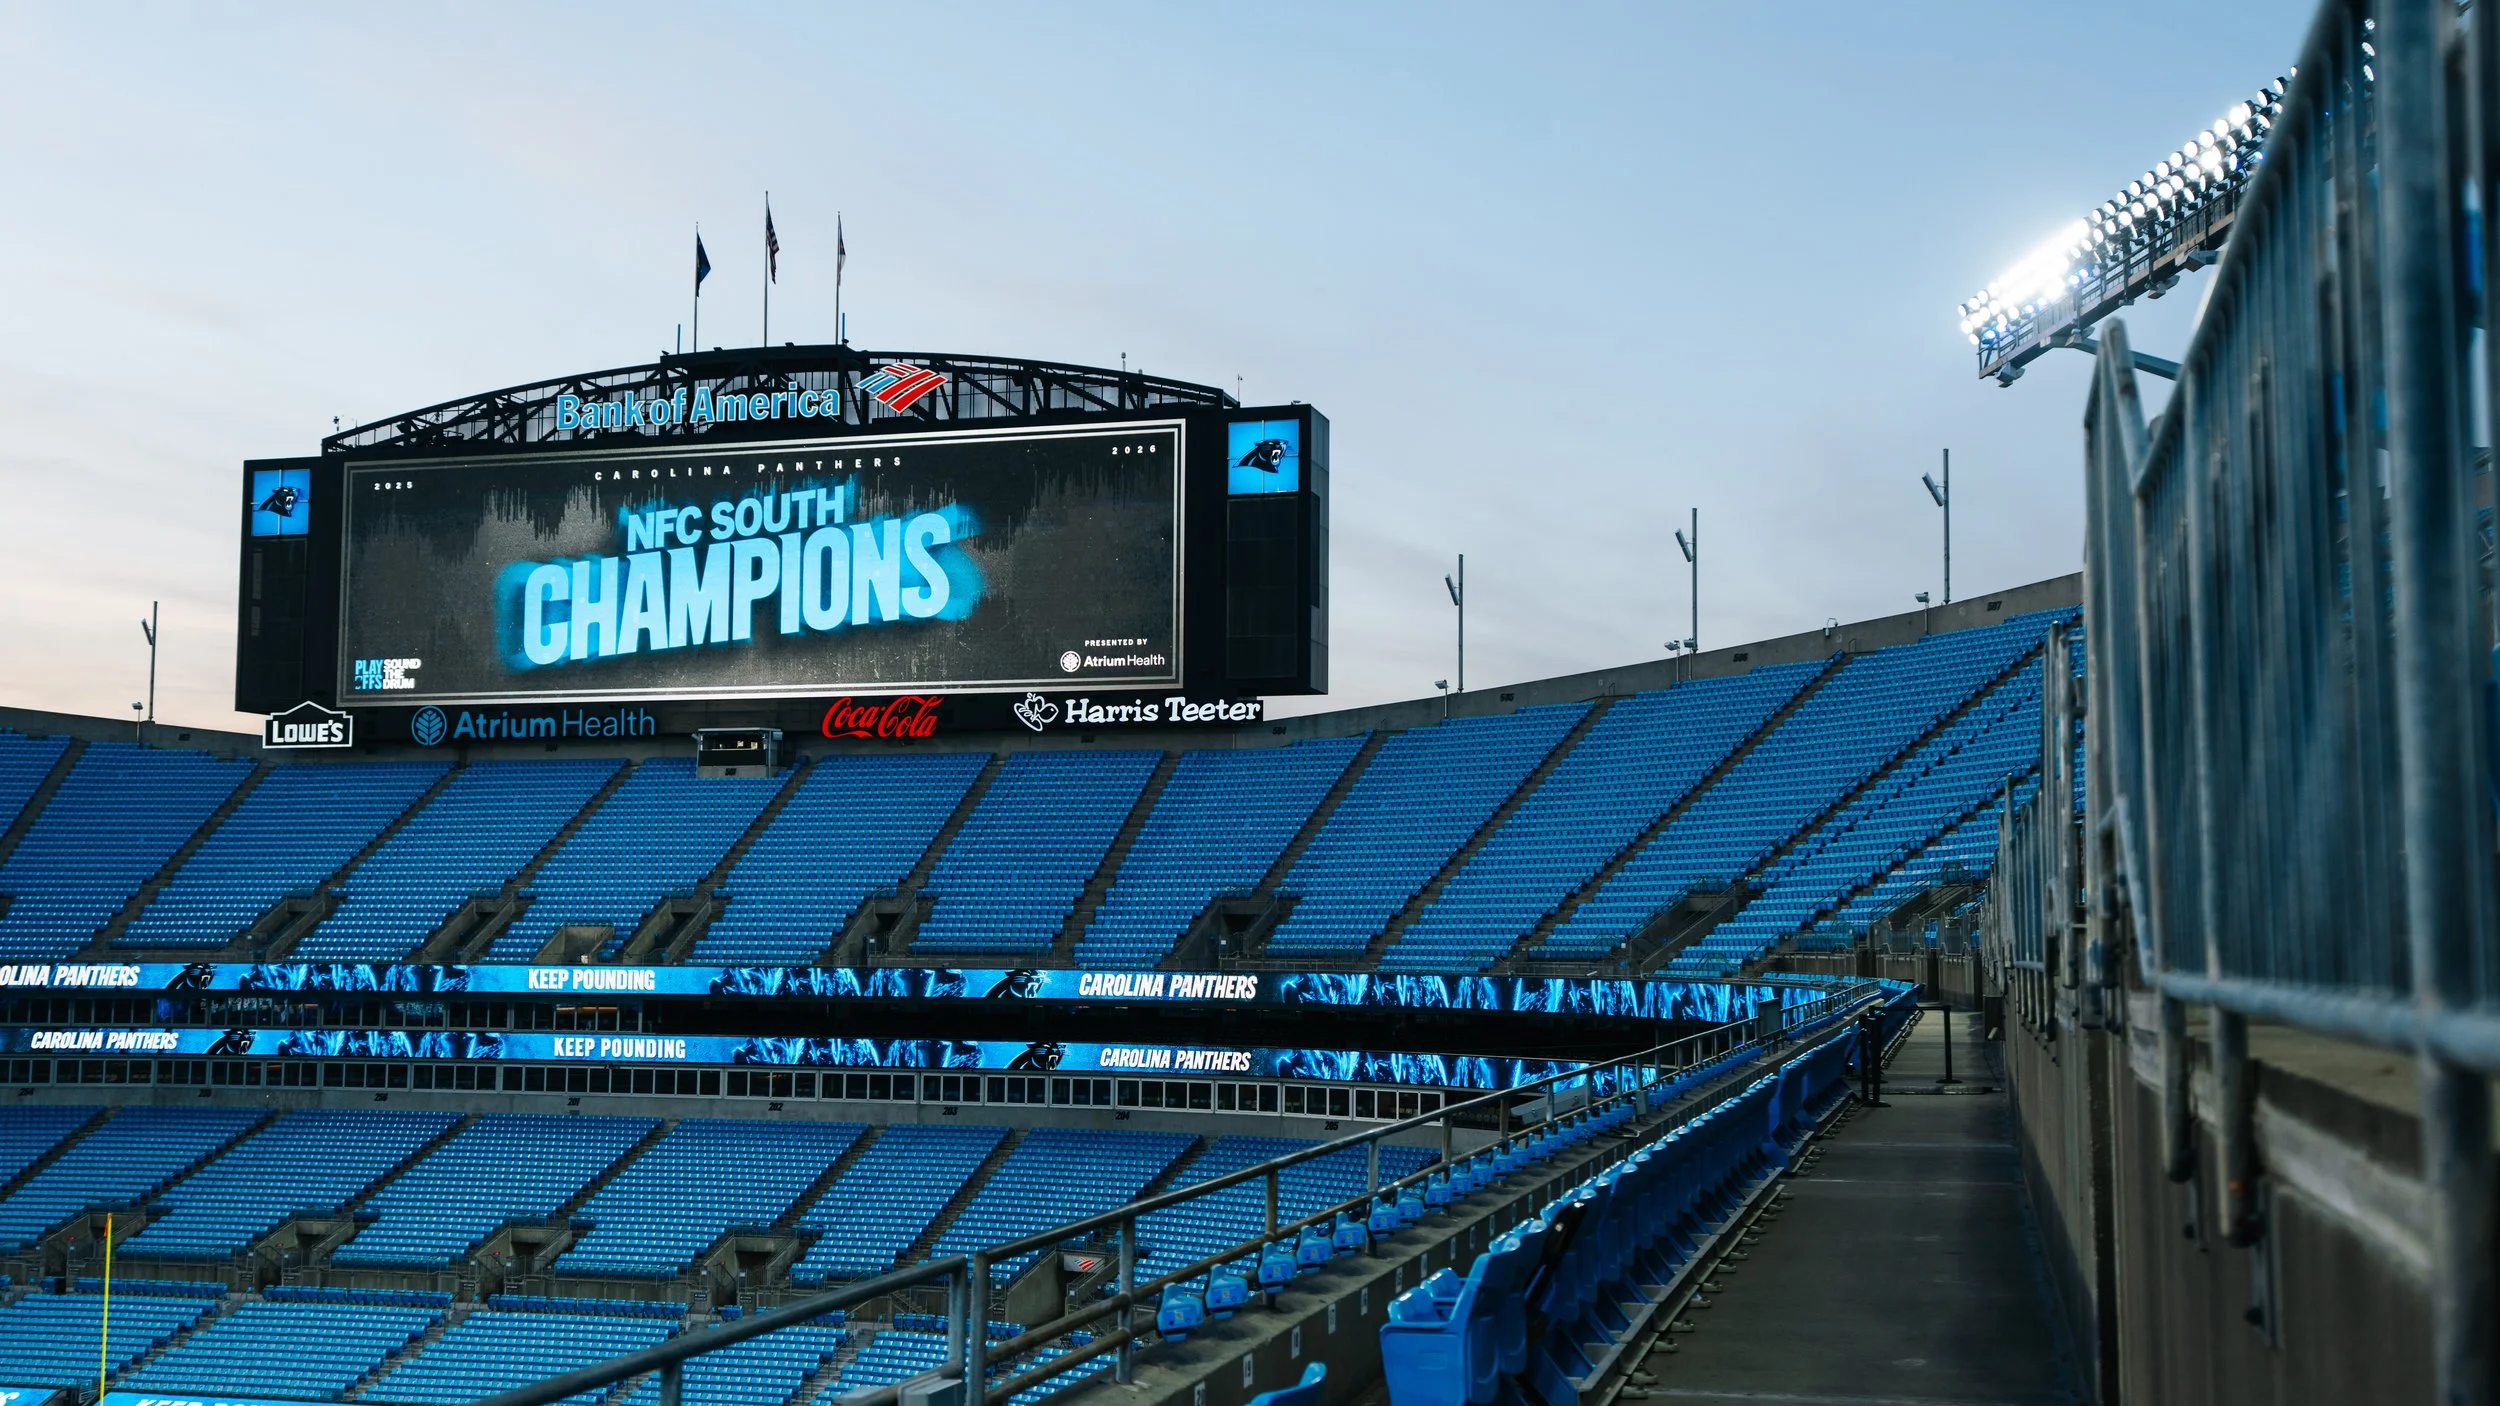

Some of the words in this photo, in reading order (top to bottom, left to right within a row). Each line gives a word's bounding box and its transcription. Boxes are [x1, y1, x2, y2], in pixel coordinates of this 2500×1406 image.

[556, 390, 645, 431] Bank
[650, 387, 688, 426] of
[690, 381, 841, 423] America
[1112, 444, 1156, 455] 2026
[594, 465, 731, 481] CAROLINA
[757, 457, 901, 474] PANTHERS
[374, 481, 412, 490] 2025
[627, 505, 701, 552] NFC
[710, 485, 845, 540] SOUTH
[523, 513, 951, 666] CHAMPIONS
[1085, 638, 1134, 646] PRESENTED
[355, 660, 383, 675] PLAY
[383, 658, 421, 669] SOUND
[1083, 656, 1125, 667] Atrium
[1127, 654, 1165, 666] Health
[383, 669, 405, 679] THE
[382, 678, 415, 690] DRUM
[1065, 699, 1159, 724] Harris
[1164, 696, 1261, 722] Teeter
[272, 719, 344, 743] LOWE'S
[453, 709, 556, 739] Atrium
[563, 707, 656, 737] Health
[53, 965, 141, 987] PANTHERS
[529, 969, 569, 989] KEEP
[572, 969, 656, 991] POUNDING
[1079, 973, 1165, 997] CAROLINA
[1169, 974, 1258, 999] PANTHERS
[31, 1032, 104, 1049] CAROLINA
[106, 1032, 179, 1050] PANTHERS
[554, 1037, 595, 1057] KEEP
[600, 1038, 686, 1059] POUNDING
[1100, 1047, 1171, 1069] CAROLINA
[1174, 1050, 1252, 1071] PANTHERS
[768, 1102, 784, 1112] 202
[942, 1106, 958, 1116] 203
[1115, 1111, 1130, 1121] 204
[1324, 1121, 1339, 1131] 205
